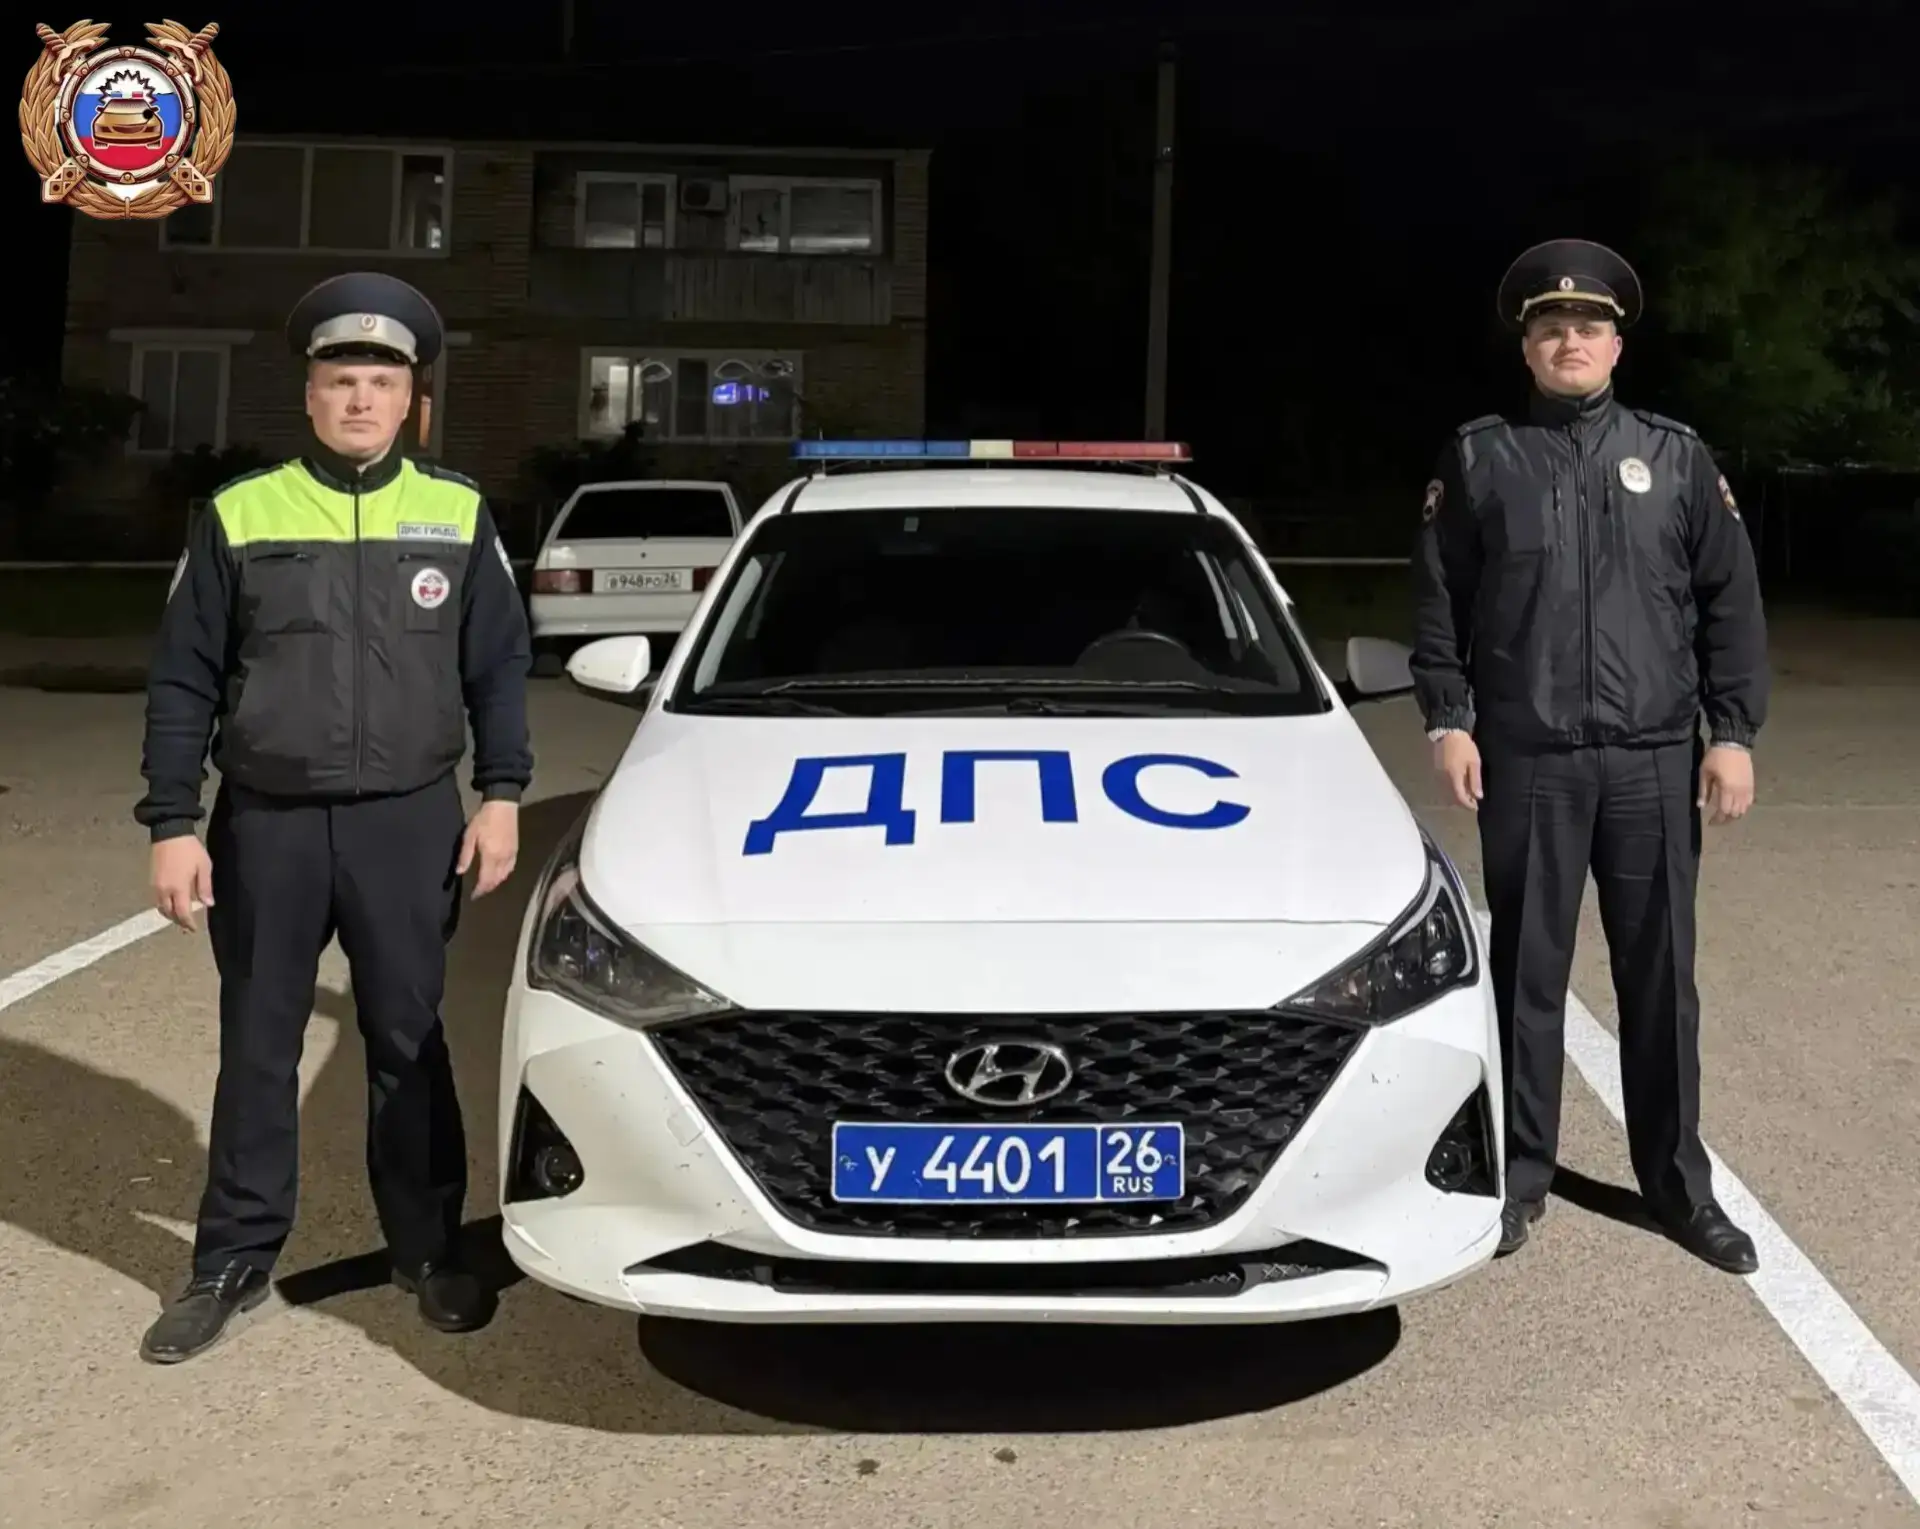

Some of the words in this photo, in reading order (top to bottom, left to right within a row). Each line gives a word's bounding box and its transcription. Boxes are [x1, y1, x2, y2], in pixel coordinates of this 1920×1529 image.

[742, 750, 1252, 856] ДПС
[922, 1136, 1066, 1194] 4401
[1106, 1130, 1163, 1175] 26
[1112, 1176, 1155, 1194] RUS
